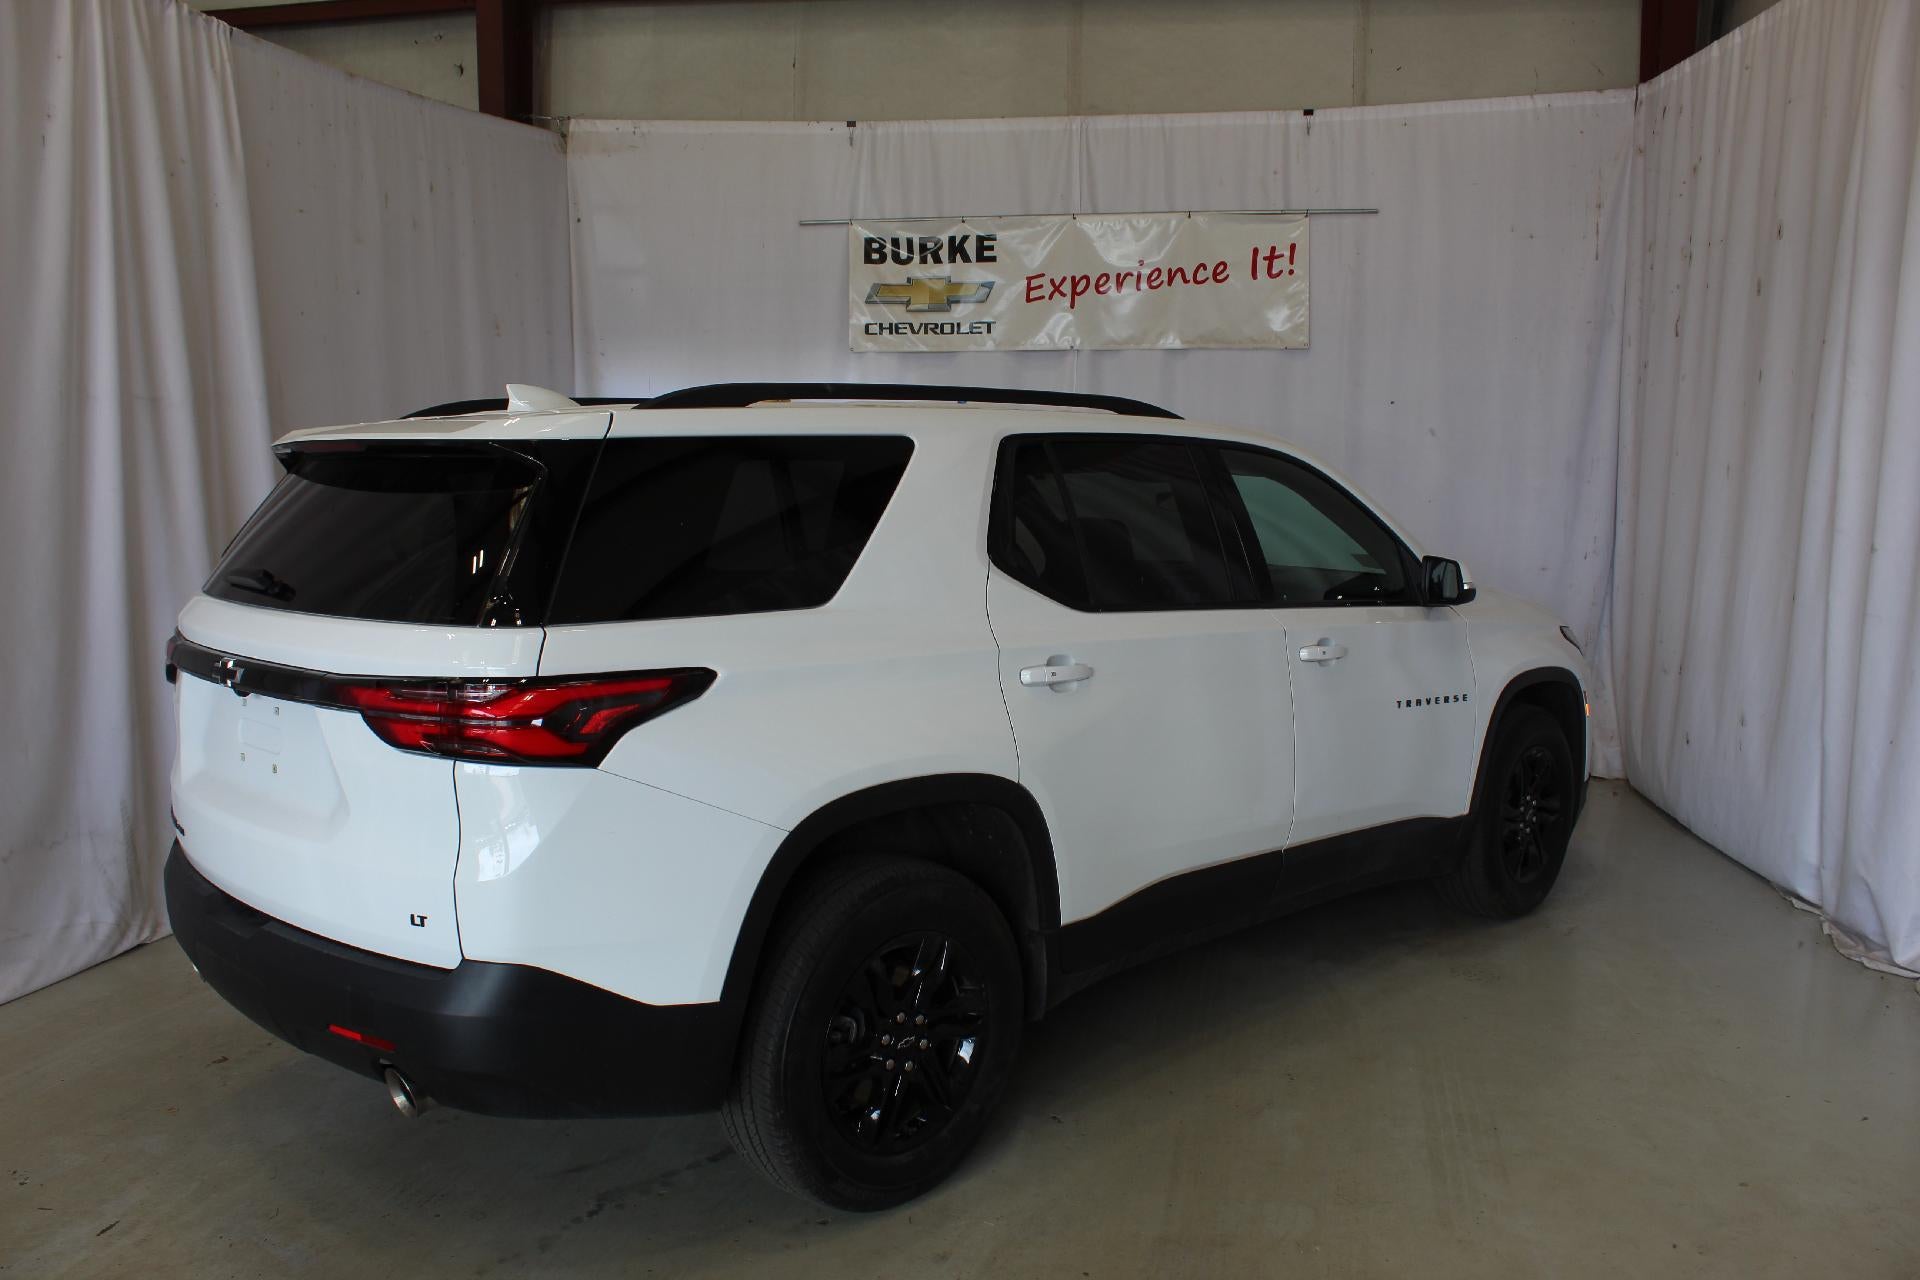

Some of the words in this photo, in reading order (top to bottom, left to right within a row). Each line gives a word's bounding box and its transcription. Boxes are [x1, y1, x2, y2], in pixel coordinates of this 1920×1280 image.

[863, 234, 997, 265] BURKE
[1024, 260, 1230, 309] Experience
[1250, 242, 1298, 281] It!
[864, 320, 997, 336] CHEVROLET
[1396, 693, 1468, 709] TRAVERSE
[410, 913, 428, 927] LT
